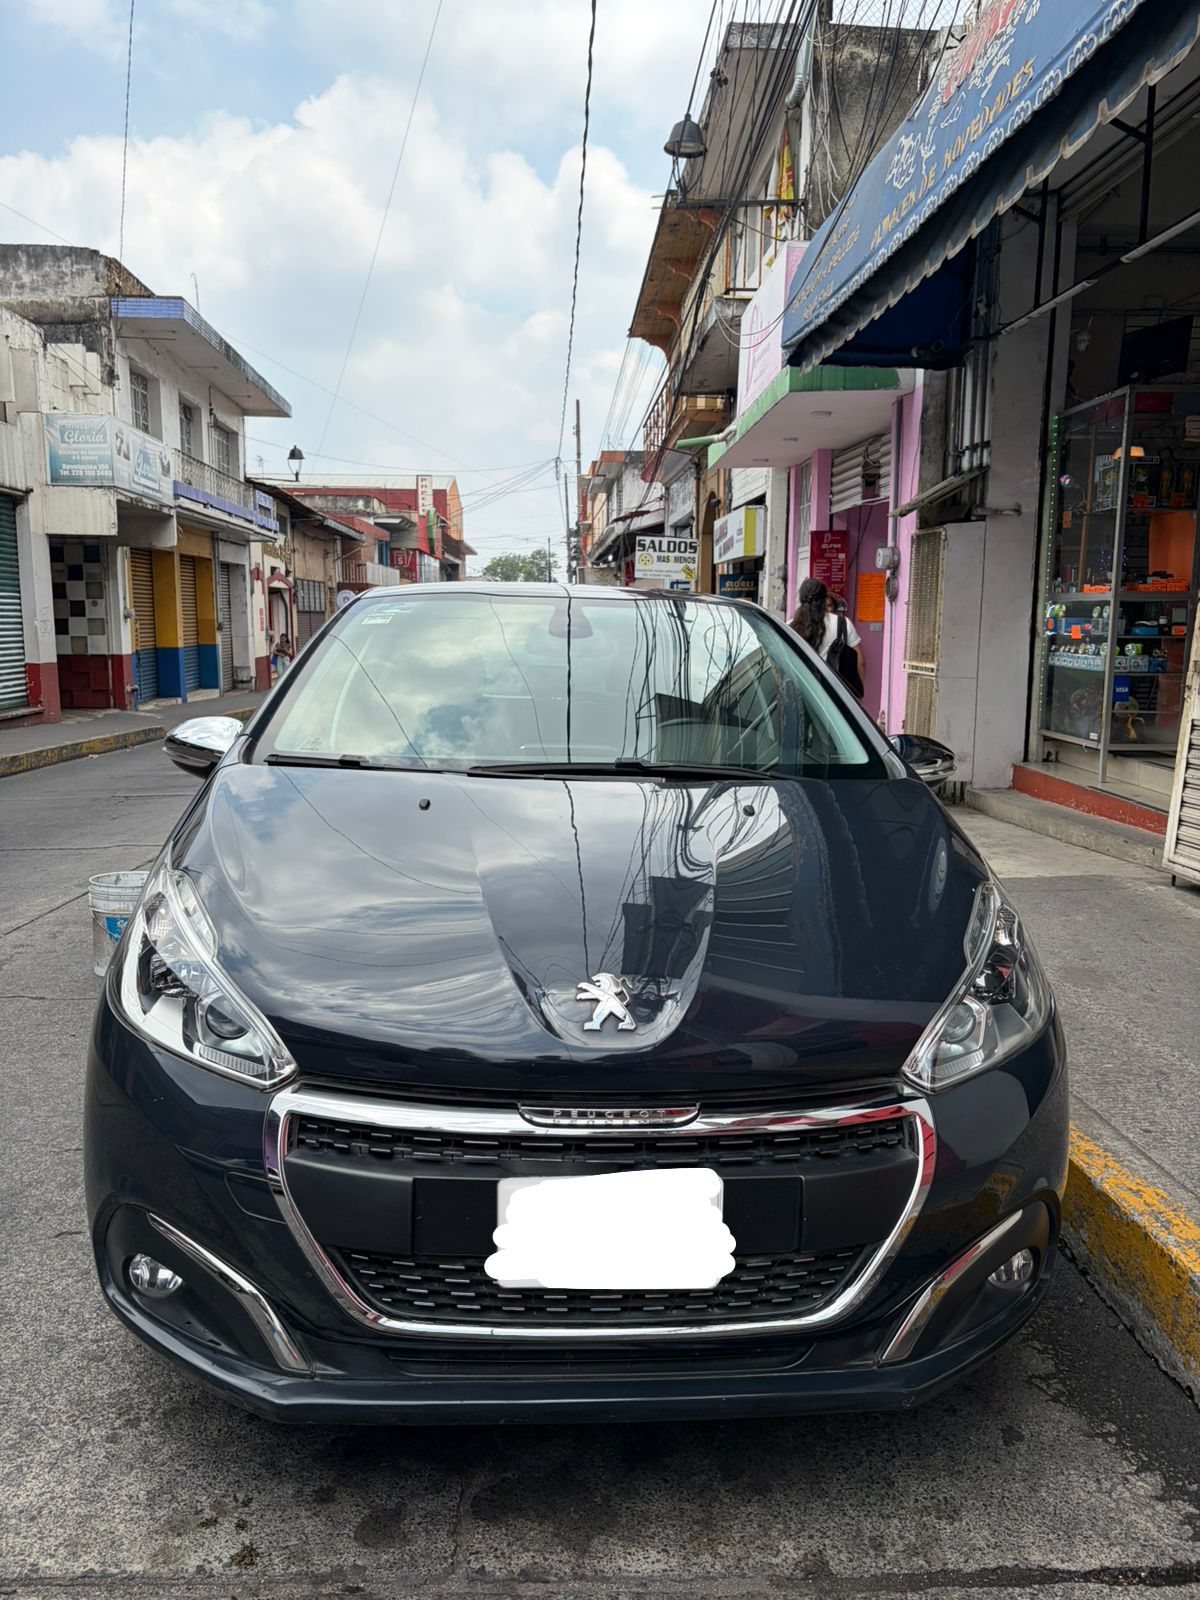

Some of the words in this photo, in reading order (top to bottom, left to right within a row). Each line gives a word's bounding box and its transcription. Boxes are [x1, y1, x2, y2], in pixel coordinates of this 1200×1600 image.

[918, 162, 938, 200] DE
[944, 57, 1035, 172] NOVEDADES
[64, 430, 104, 445] Gloria
[637, 539, 697, 554] SALDOS
[656, 555, 670, 563] MAS
[673, 556, 696, 564] MENOS
[552, 1109, 666, 1118] PEUGEOT
